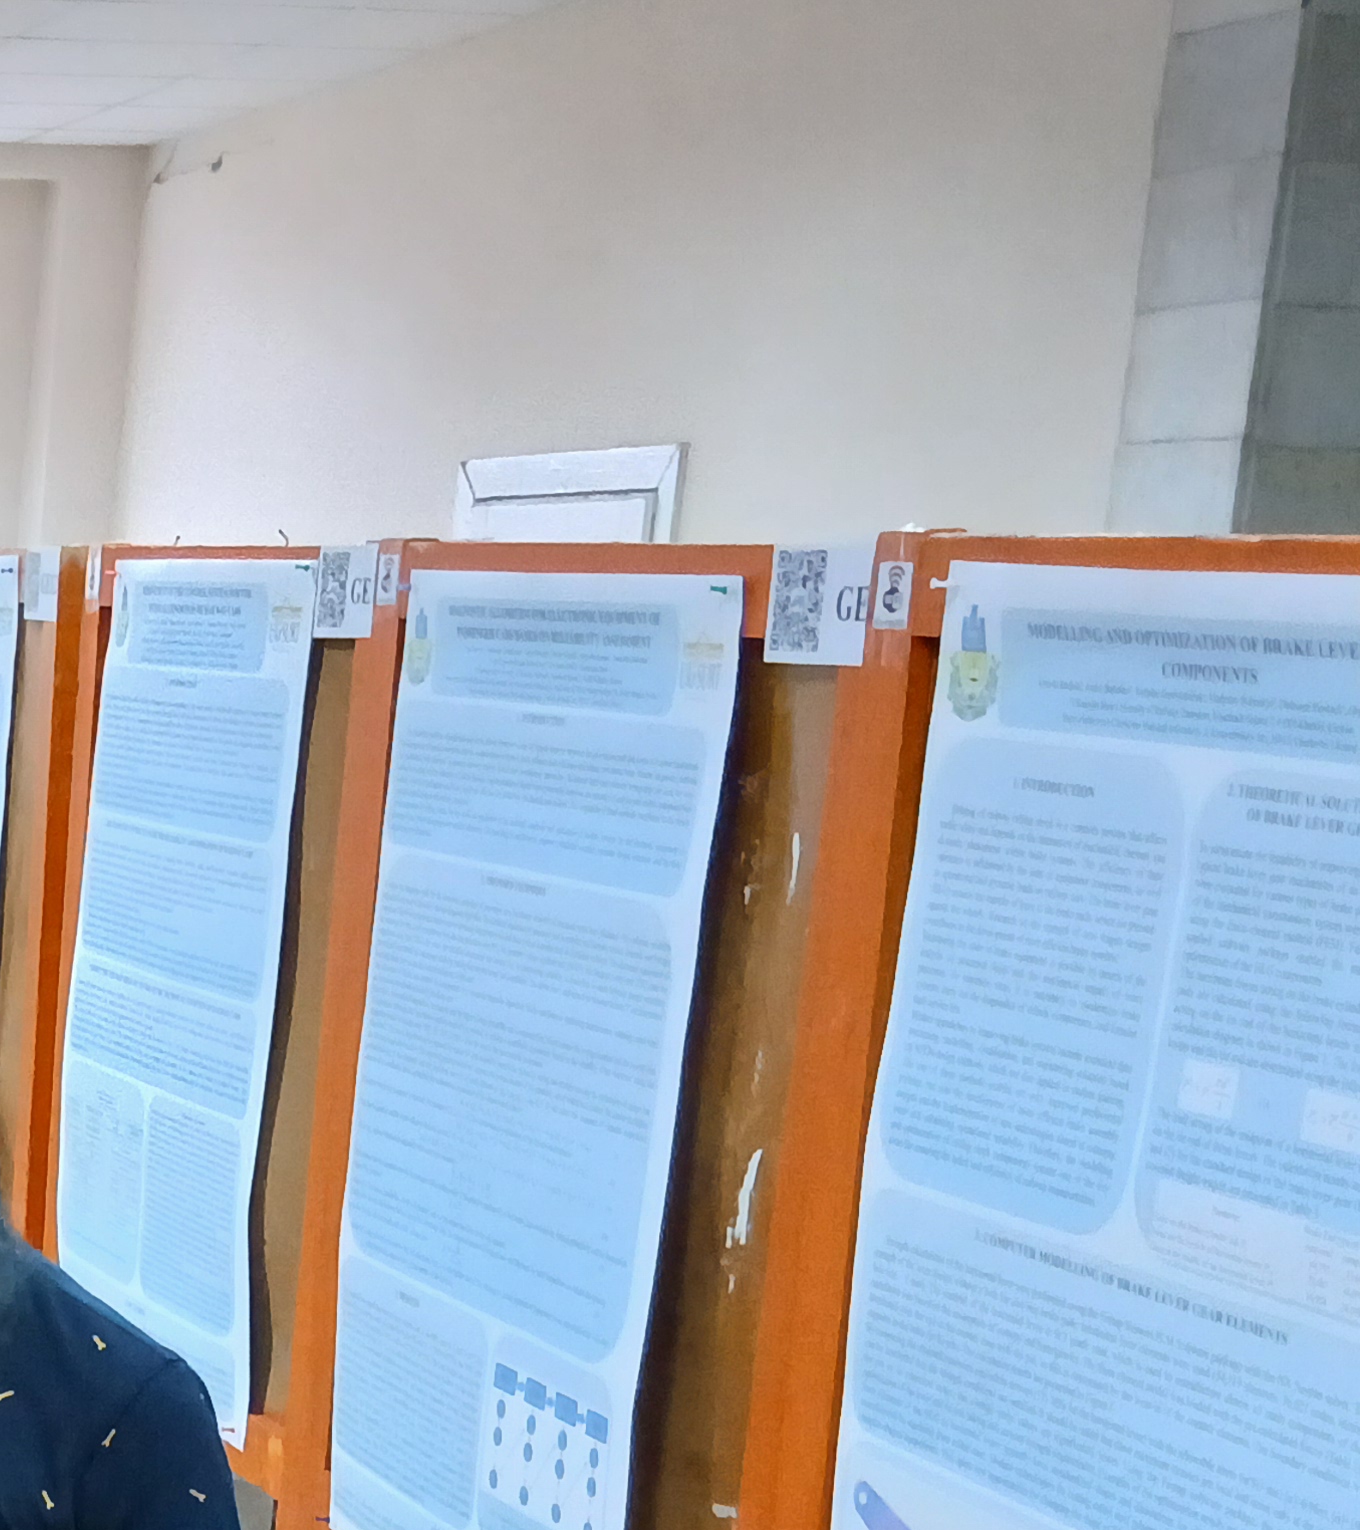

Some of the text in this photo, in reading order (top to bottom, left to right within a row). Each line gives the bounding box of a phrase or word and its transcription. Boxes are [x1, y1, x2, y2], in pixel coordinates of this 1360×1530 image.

[350, 576, 371, 605] GE
[1028, 622, 1103, 643] MODELLING
[1106, 627, 1132, 645] AND
[1134, 630, 1237, 652] OPTIMIZATION
[1240, 635, 1259, 653] OF
[1263, 637, 1314, 657] BRAKE
[1161, 662, 1259, 684] COMPONENTS
